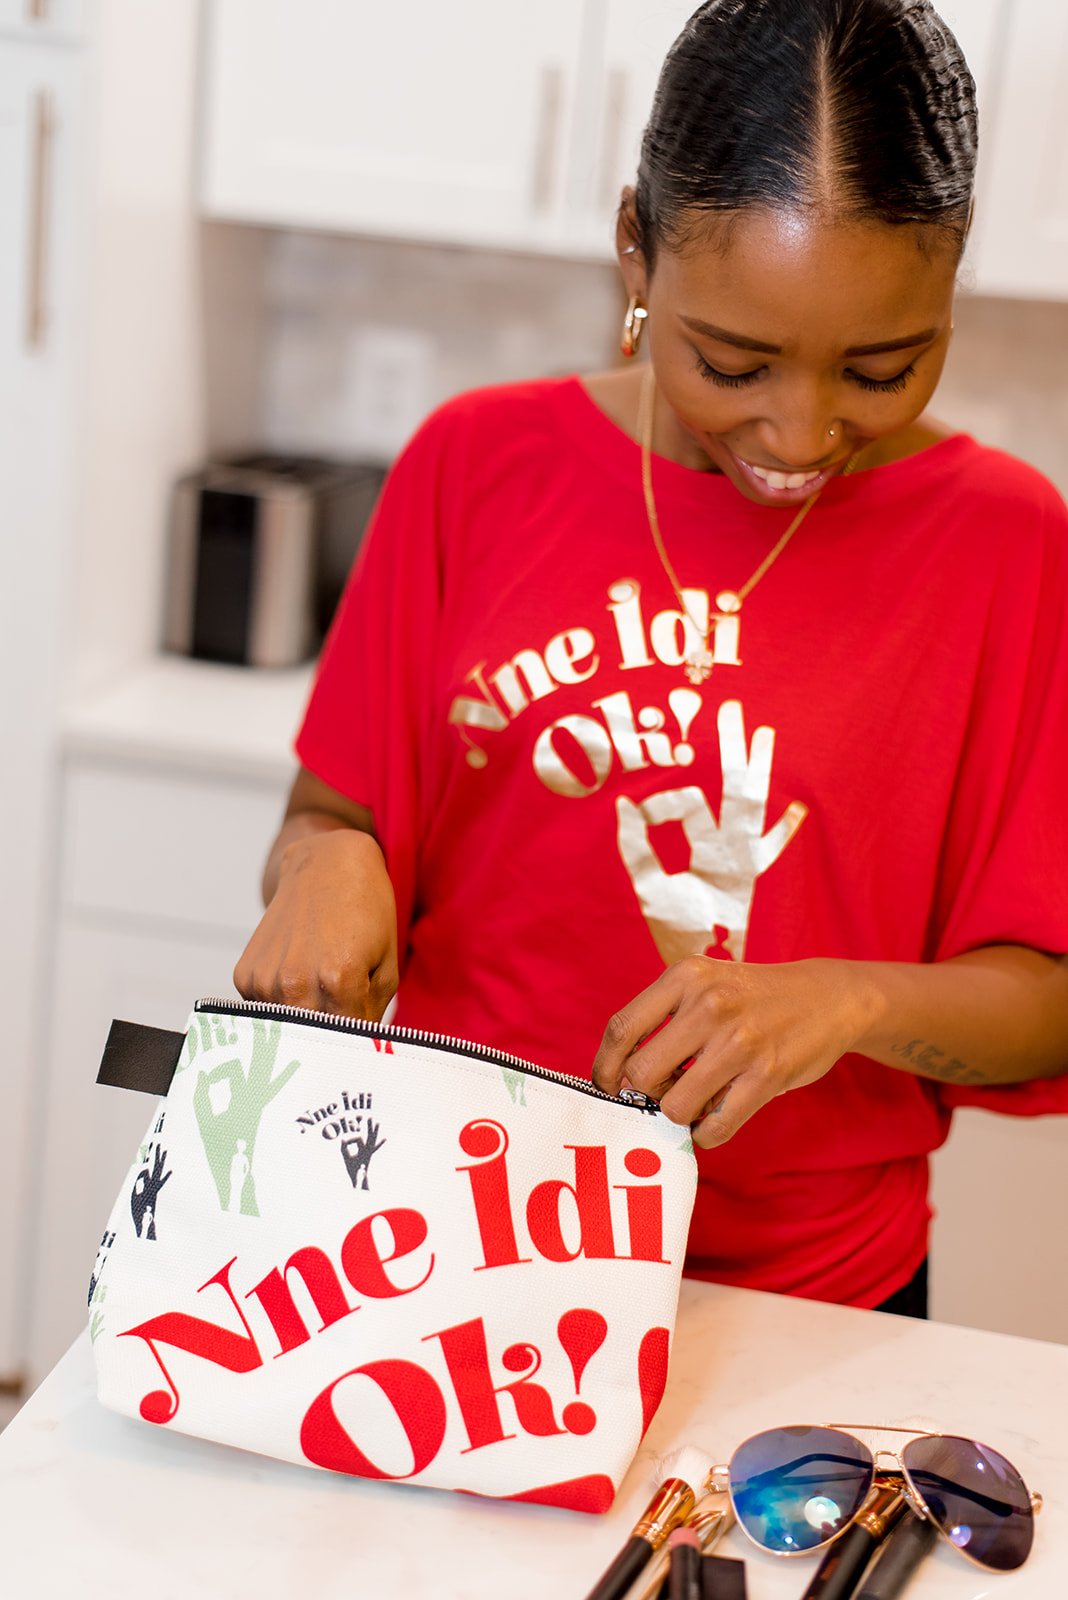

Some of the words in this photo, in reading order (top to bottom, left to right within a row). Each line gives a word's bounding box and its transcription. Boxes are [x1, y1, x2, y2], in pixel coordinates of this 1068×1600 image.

[447, 626, 600, 770] Nne
[532, 687, 703, 798] Ok!
[296, 1102, 340, 1134] Nne
[321, 1115, 363, 1141] Ok!
[116, 1207, 435, 1424] Nne
[300, 1308, 608, 1480] Ok!
